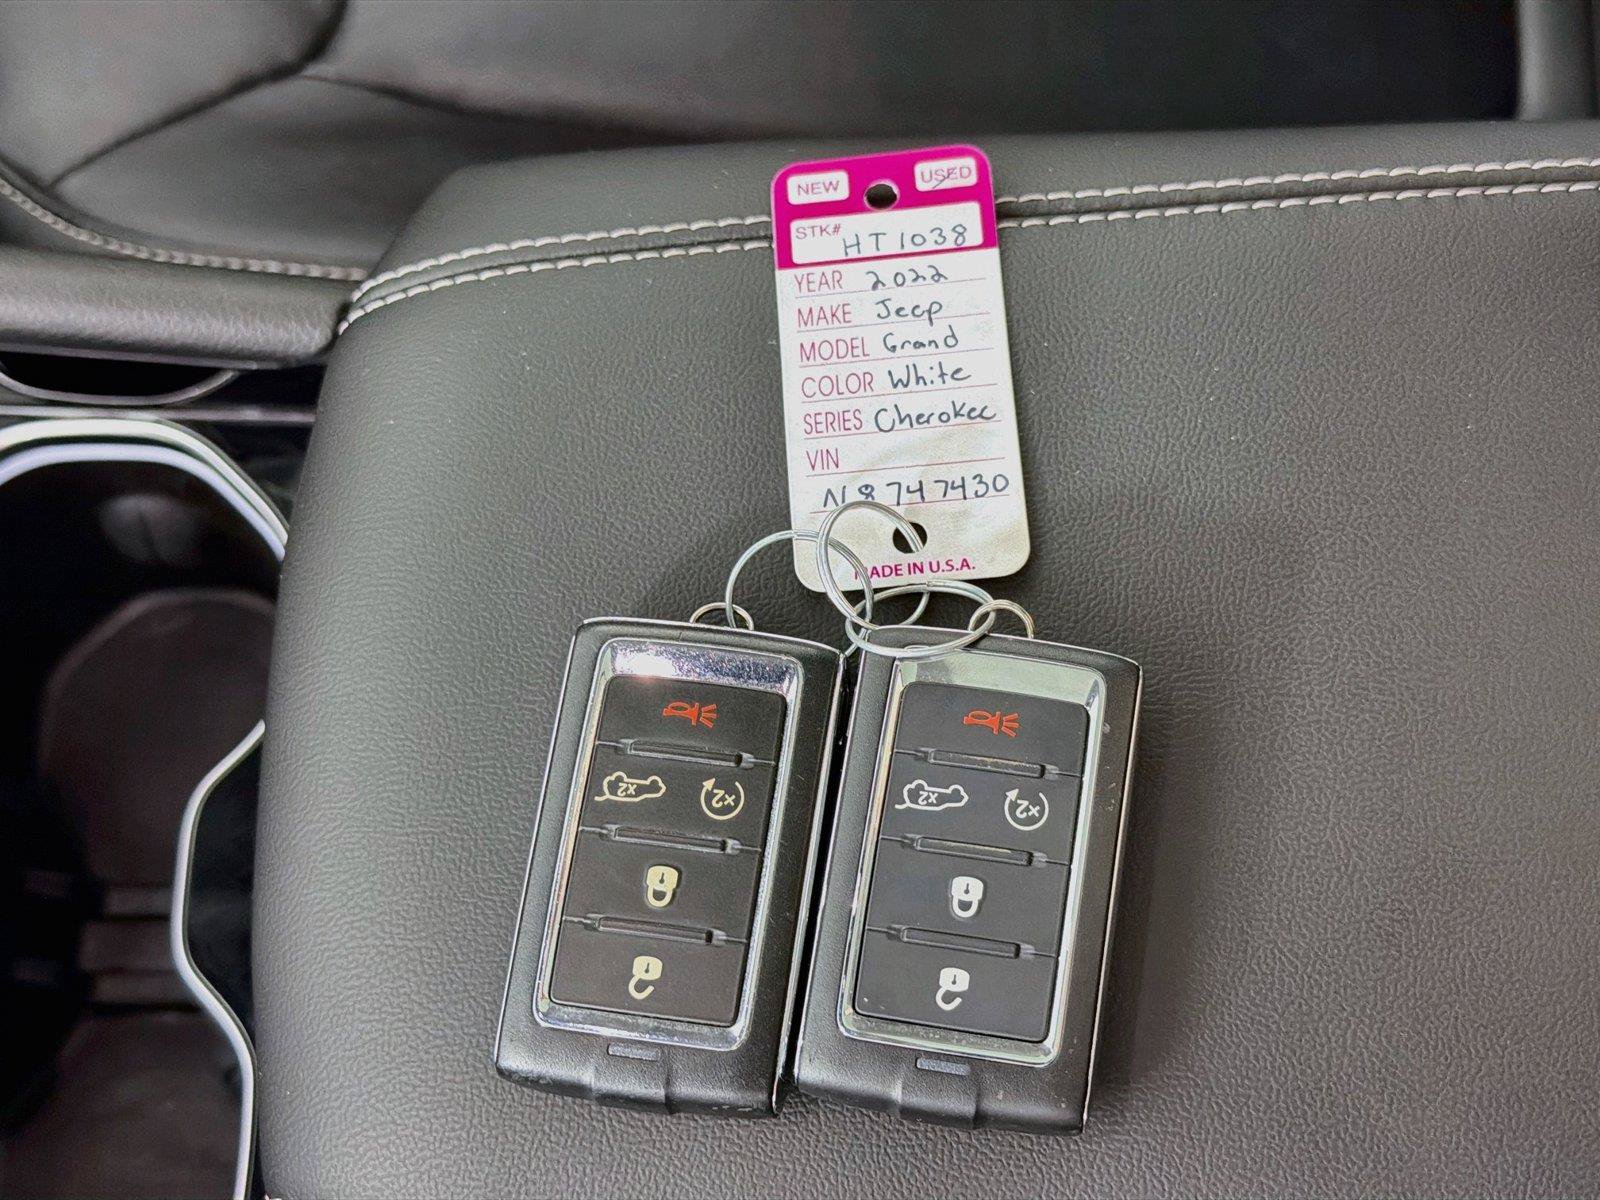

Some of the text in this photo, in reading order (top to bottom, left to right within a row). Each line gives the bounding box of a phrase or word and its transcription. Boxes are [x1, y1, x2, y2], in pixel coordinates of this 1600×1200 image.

[920, 165, 972, 184] USED
[797, 180, 840, 196] NEW
[795, 224, 842, 240] STK#
[794, 270, 843, 293] YEAR
[866, 265, 948, 291] 2022
[797, 303, 852, 328] MAKE
[875, 298, 943, 327] Jeep
[799, 336, 870, 362] MODEL
[882, 325, 959, 353] Grand
[801, 371, 874, 399] COLOR
[888, 364, 972, 390] White
[803, 408, 863, 435] SERIES
[874, 400, 997, 433] Cherokee
[805, 448, 840, 472] VIN
[908, 561, 924, 576] IN
[928, 558, 976, 574] U.S.A.
